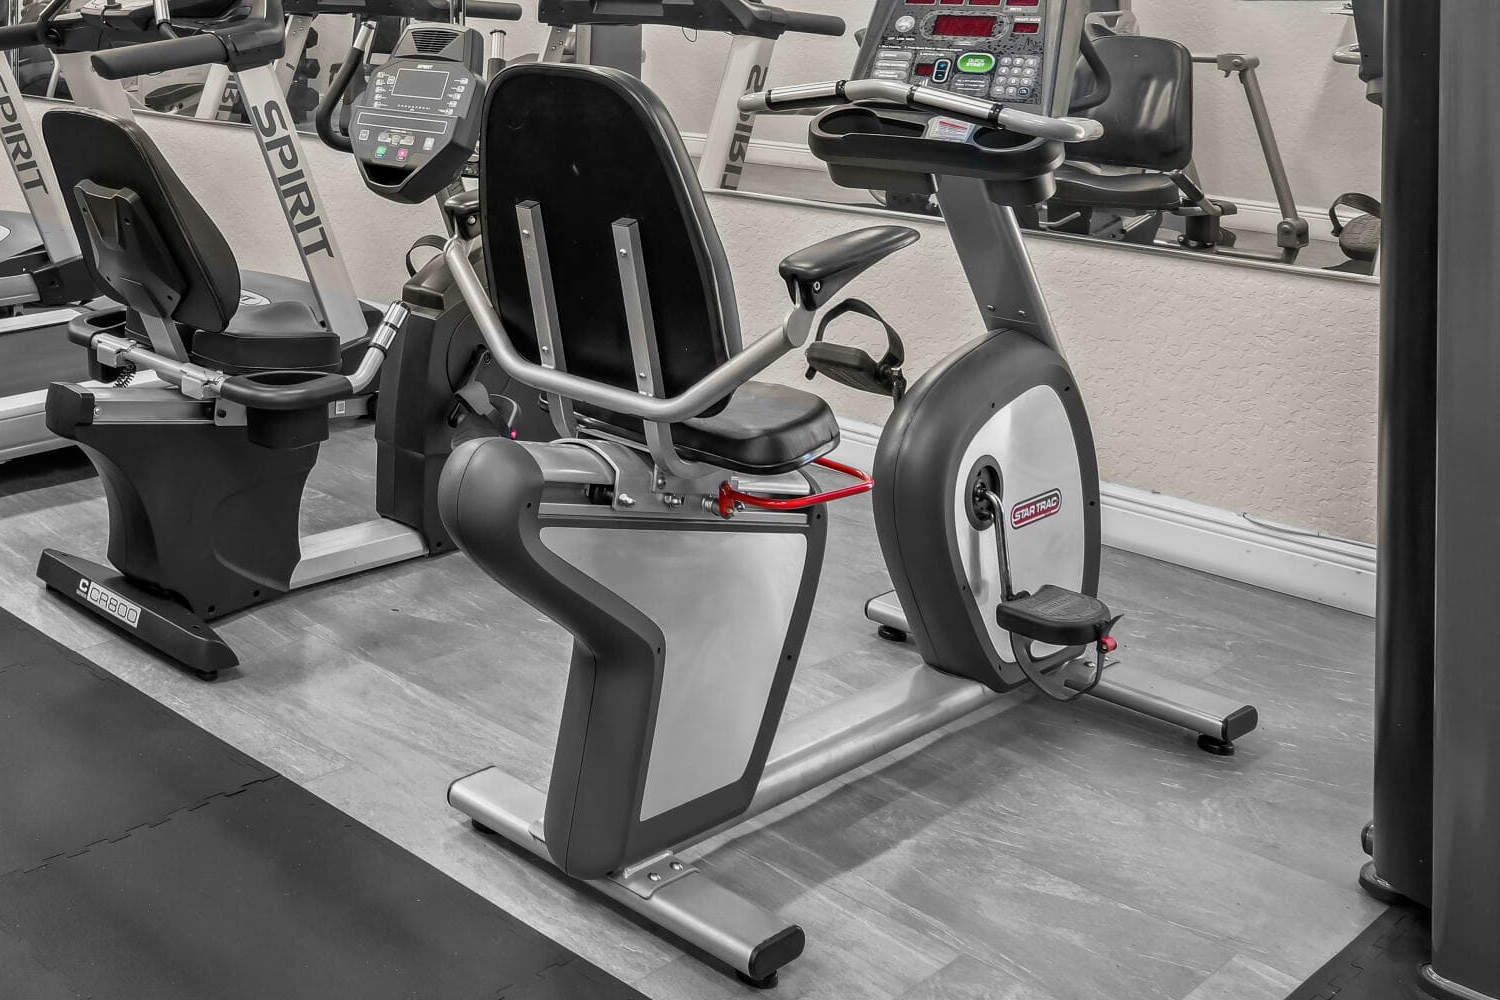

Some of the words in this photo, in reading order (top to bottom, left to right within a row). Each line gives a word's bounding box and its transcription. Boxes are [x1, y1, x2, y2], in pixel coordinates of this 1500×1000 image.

[252, 100, 335, 258] SPIRIT
[1015, 505, 1036, 520] STAR
[1036, 496, 1058, 512] TRAC
[90, 587, 138, 624] CR800
